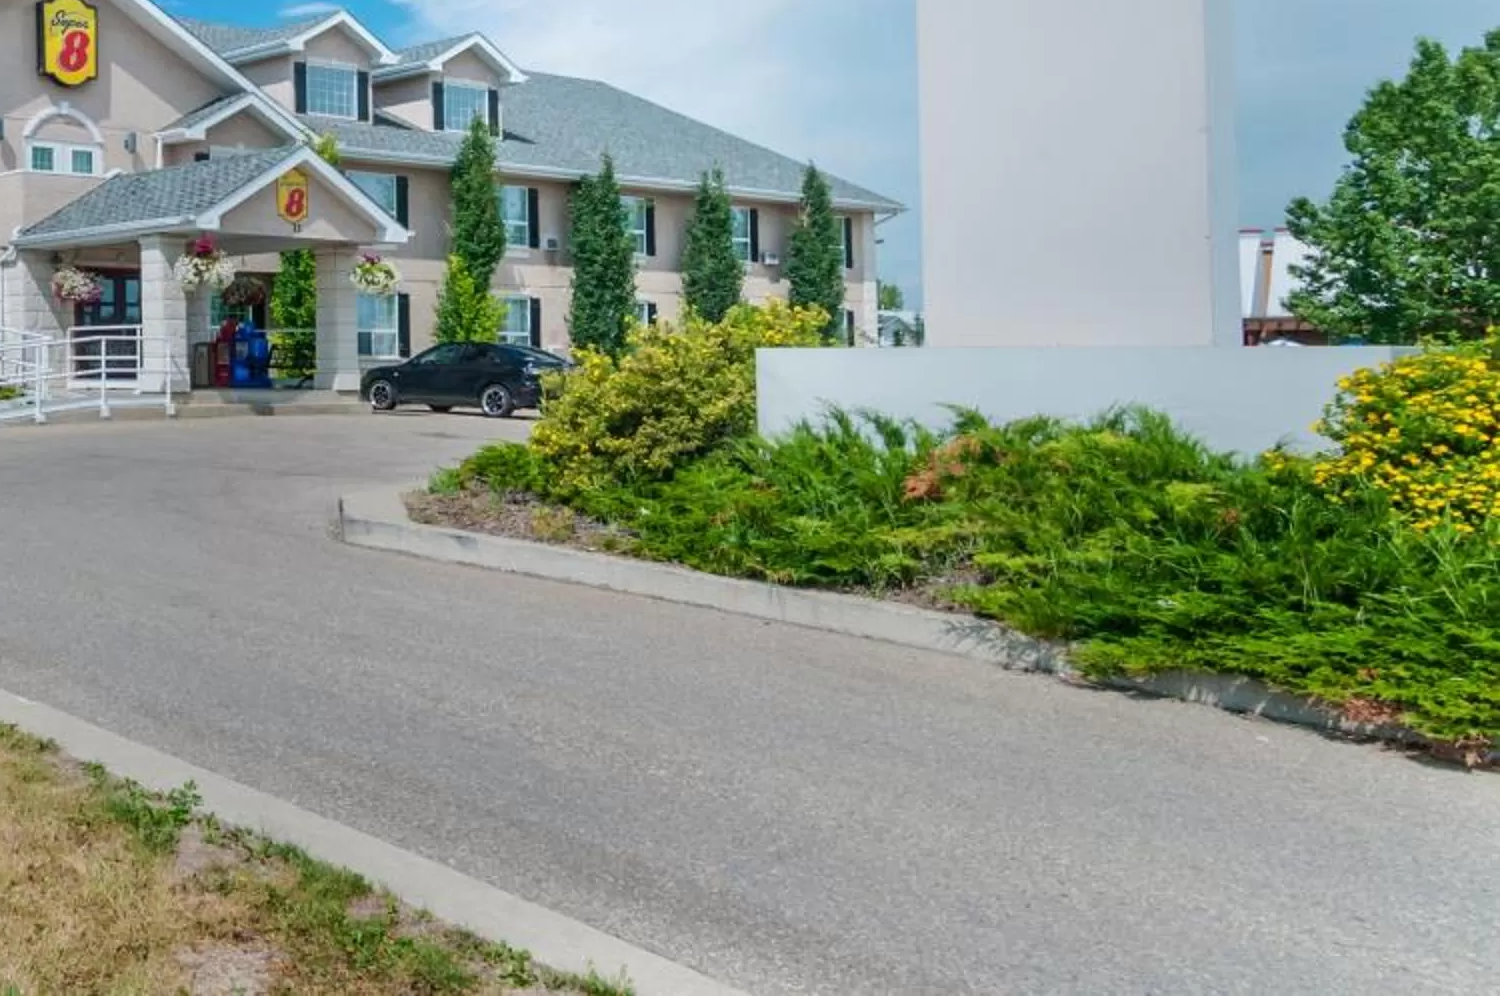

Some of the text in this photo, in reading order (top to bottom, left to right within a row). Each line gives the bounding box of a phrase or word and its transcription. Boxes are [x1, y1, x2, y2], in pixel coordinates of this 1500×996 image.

[52, 10, 89, 35] Super
[59, 30, 90, 73] 8
[284, 187, 305, 218] 8
